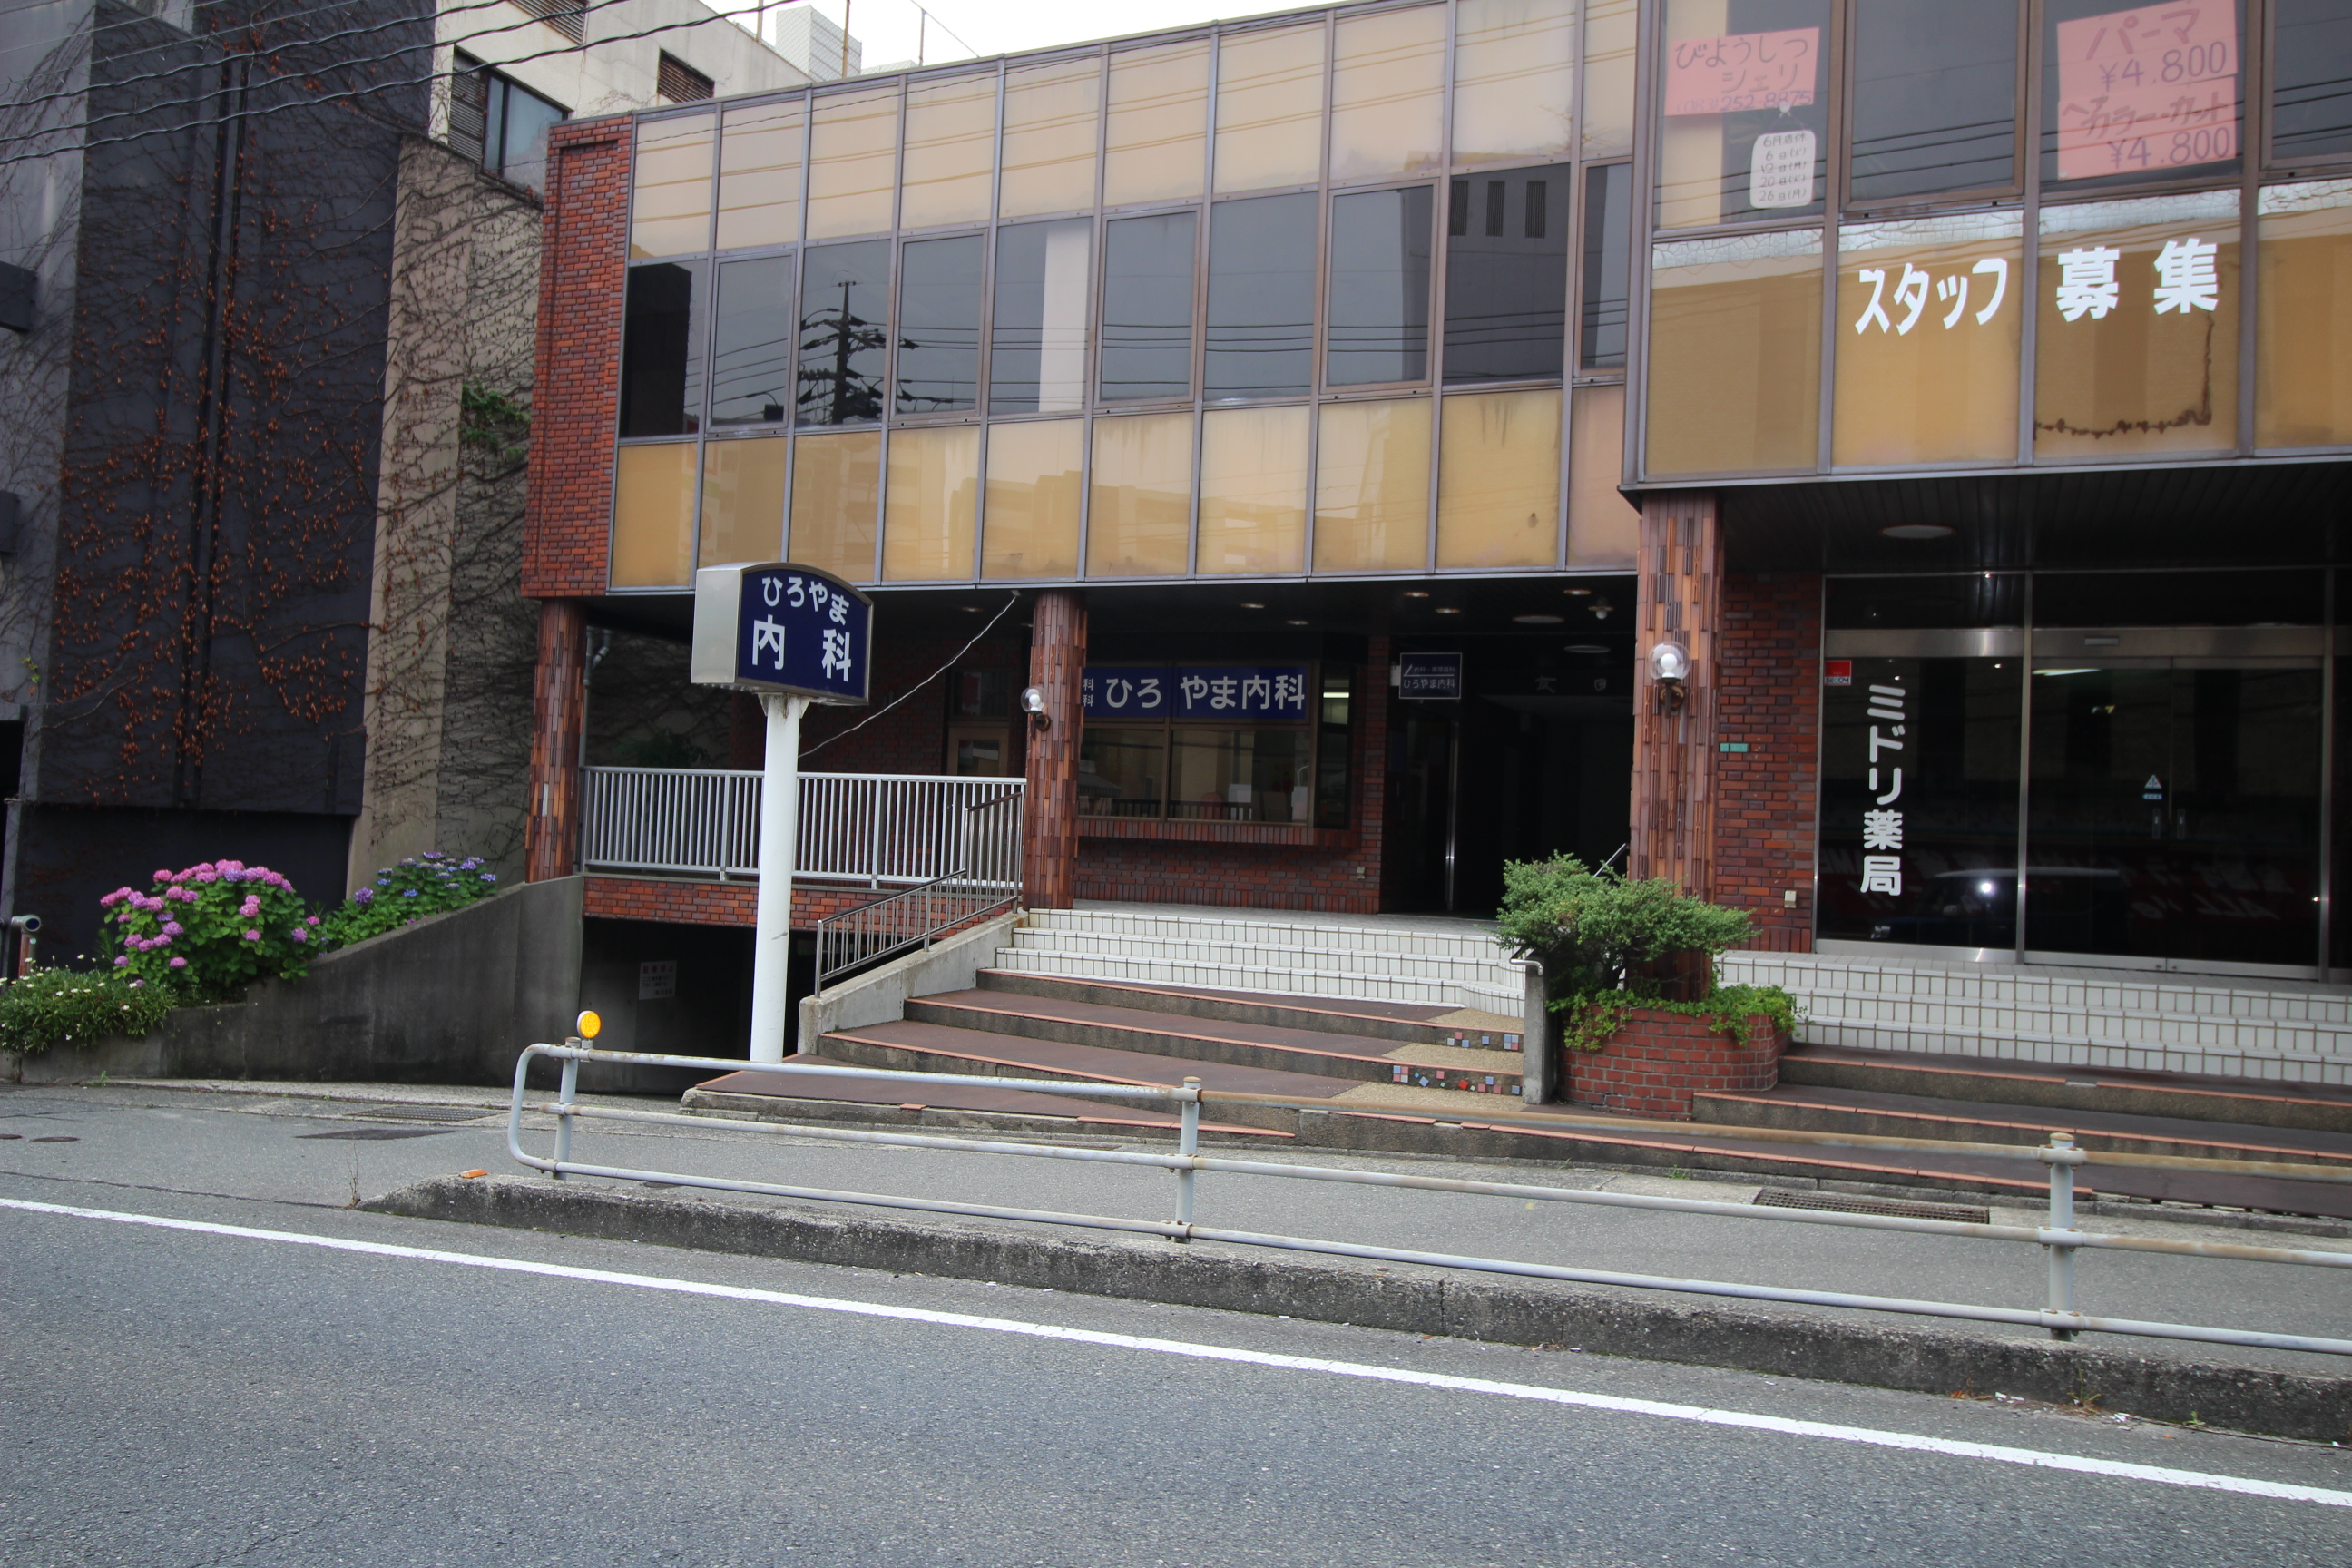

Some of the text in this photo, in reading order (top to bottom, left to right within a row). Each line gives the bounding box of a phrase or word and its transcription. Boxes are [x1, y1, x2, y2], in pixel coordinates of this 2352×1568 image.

[1674, 33, 1808, 70] びようしつ
[2086, 9, 2200, 60] パーマ
[1721, 63, 1798, 94] シェリ
[761, 575, 850, 627] ひろやま
[751, 613, 852, 682] 内科
[1105, 673, 1306, 710] ひろやま内科
[1403, 678, 1455, 689] ひろやま内科
[1860, 683, 1906, 897] ミドリ薬局
